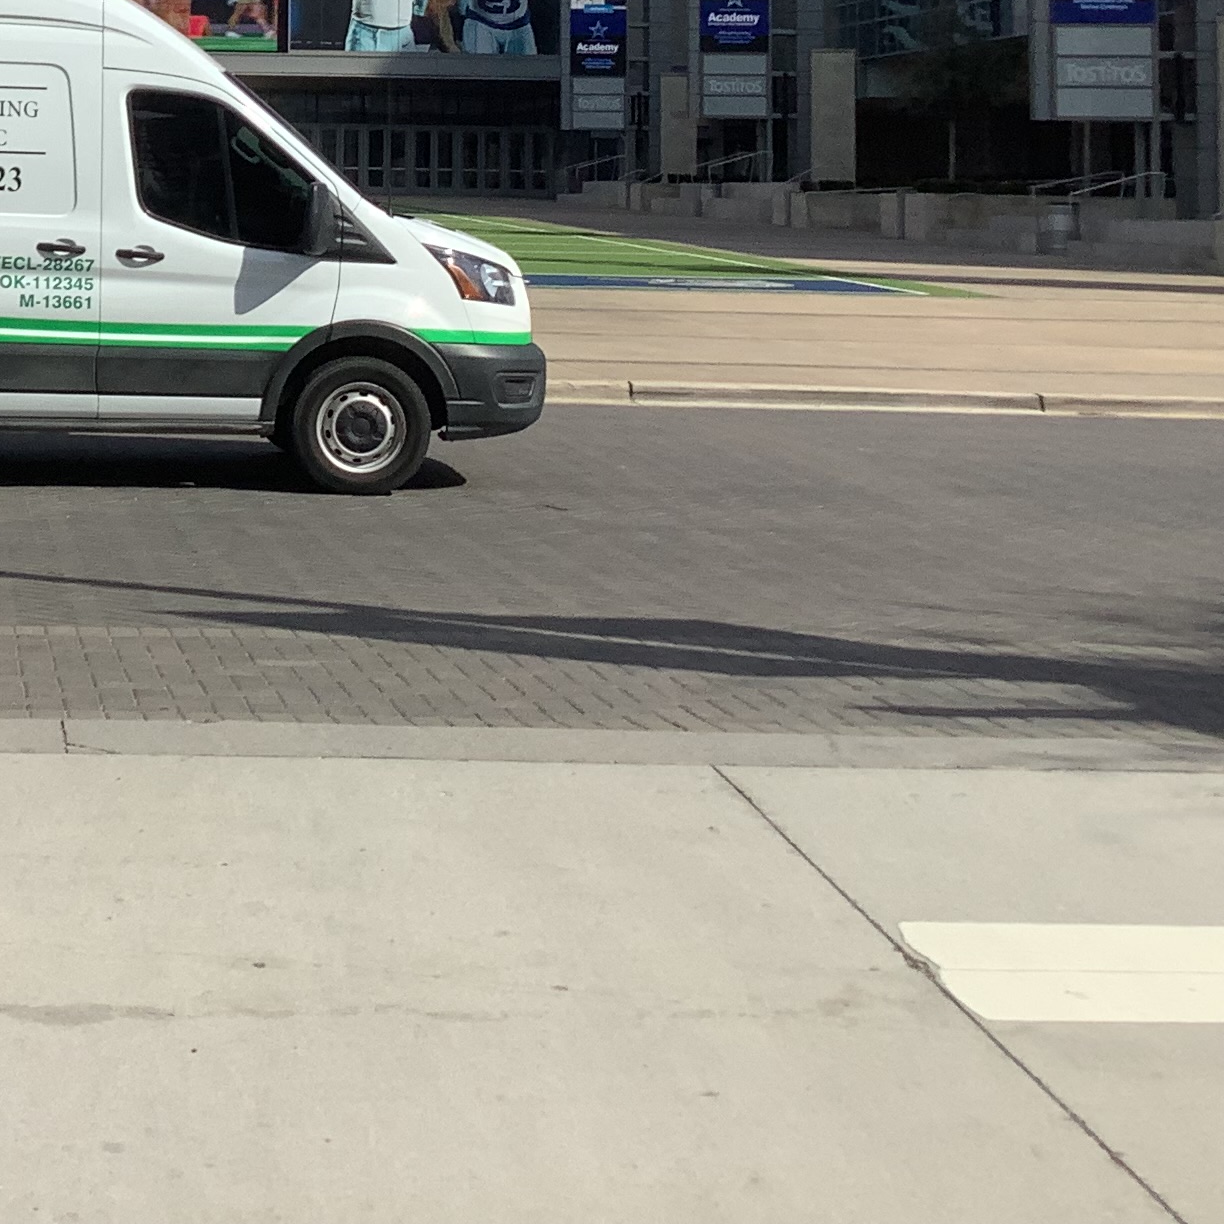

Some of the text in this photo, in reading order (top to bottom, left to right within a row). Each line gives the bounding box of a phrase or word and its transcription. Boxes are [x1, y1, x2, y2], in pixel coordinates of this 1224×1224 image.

[707, 12, 761, 25] Academy
[576, 42, 619, 53] Academy
[19, 294, 93, 309] M-13661
